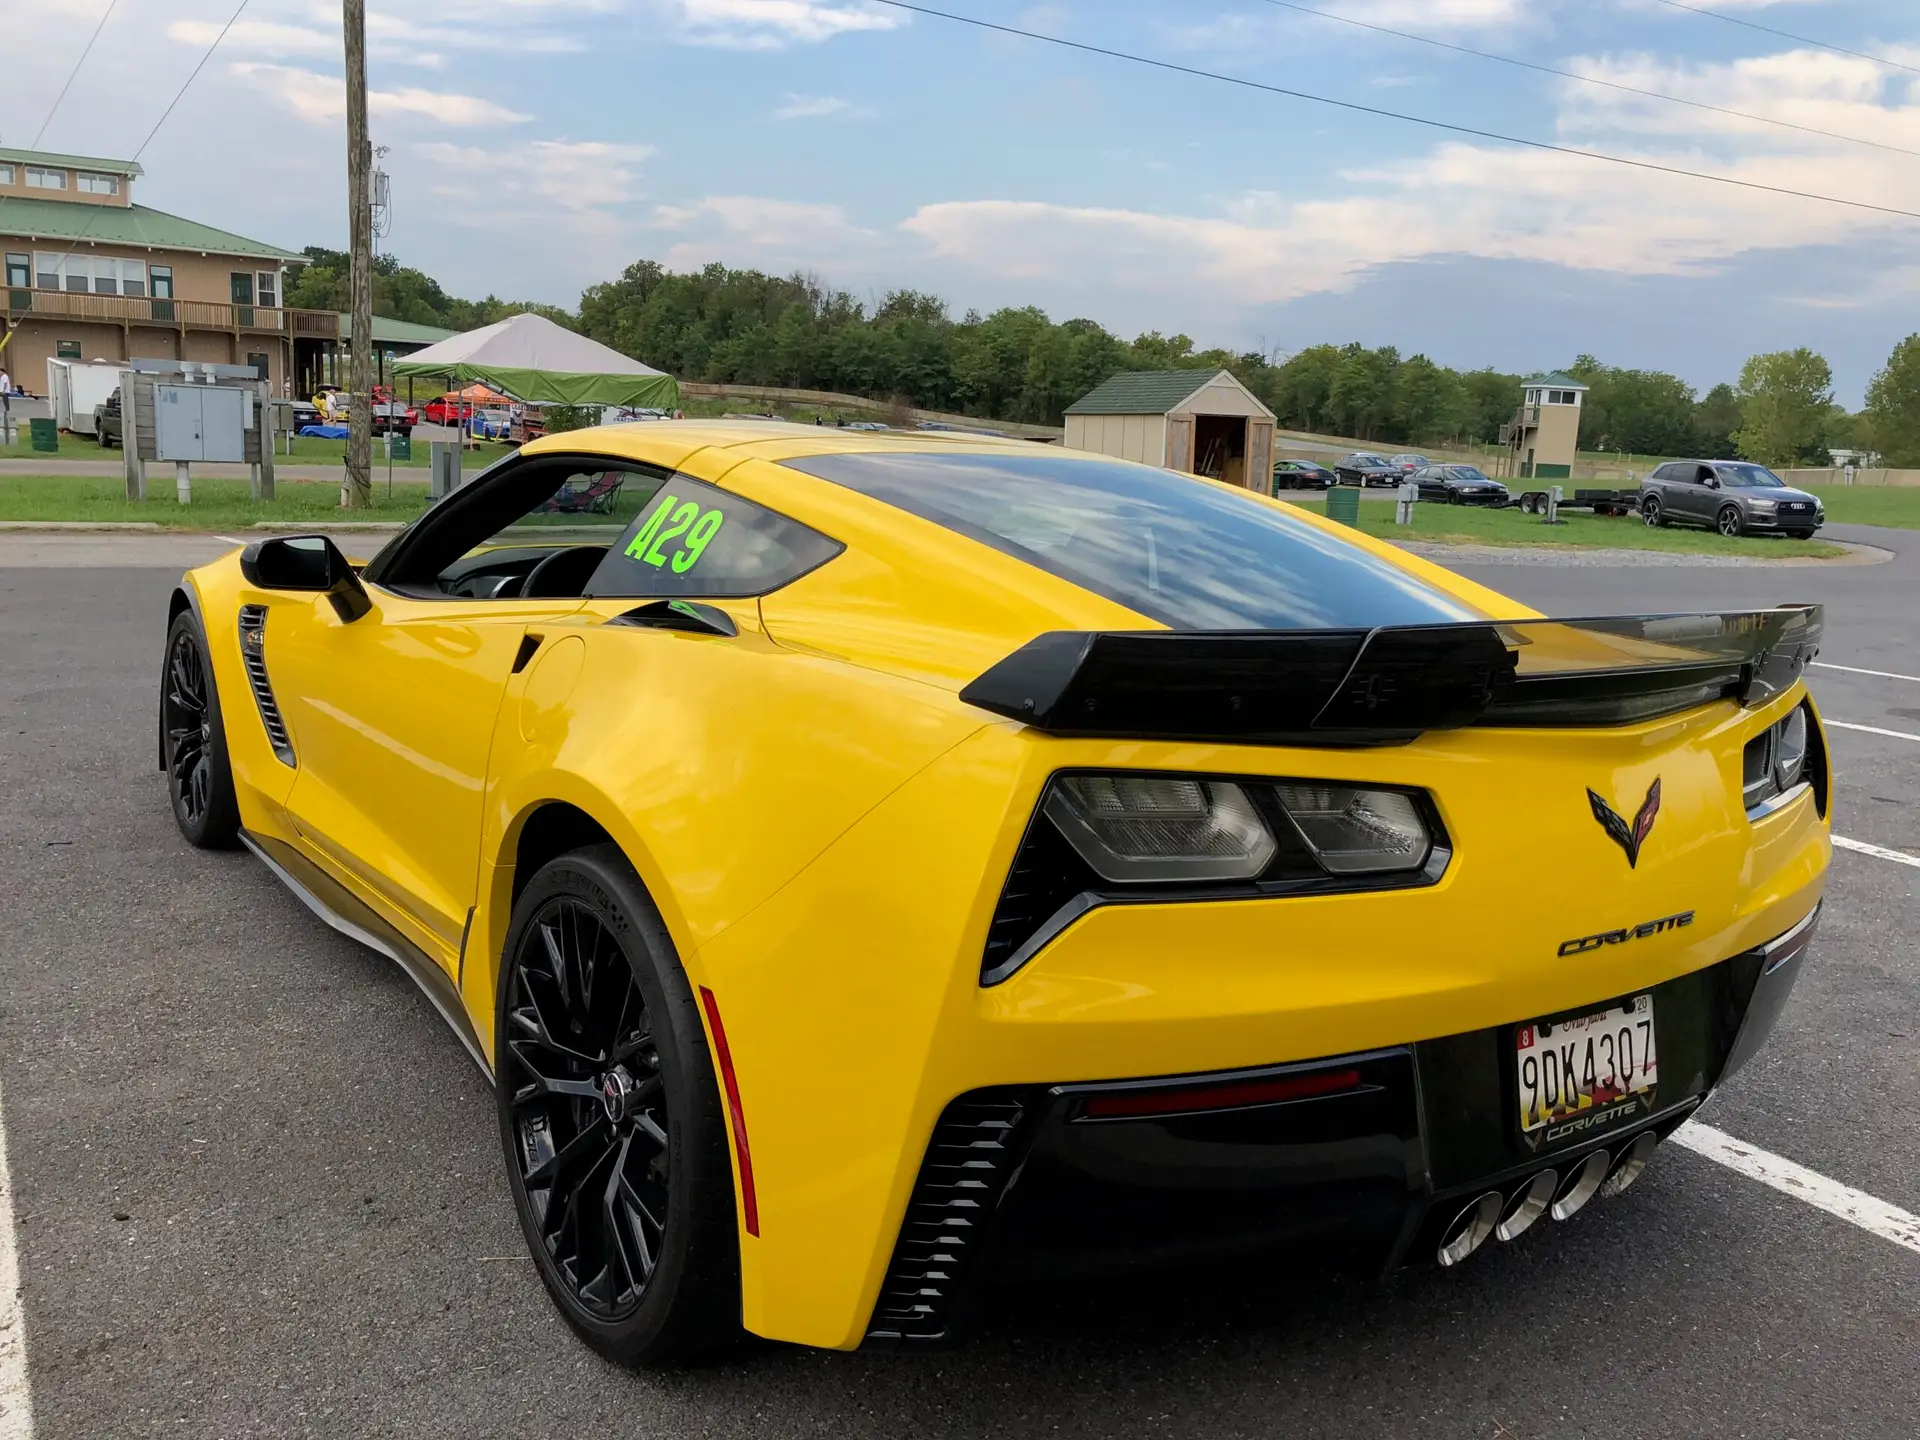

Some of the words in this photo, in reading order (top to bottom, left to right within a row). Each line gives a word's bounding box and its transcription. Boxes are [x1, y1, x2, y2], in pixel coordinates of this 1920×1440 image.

[624, 495, 723, 573] A29
[1557, 909, 1696, 957] CORVETTE
[1636, 997, 1648, 1011] 20
[1522, 1030, 1530, 1047] 8
[1522, 1019, 1651, 1114] 9DK4307
[1546, 1100, 1637, 1142] CORVETTE
